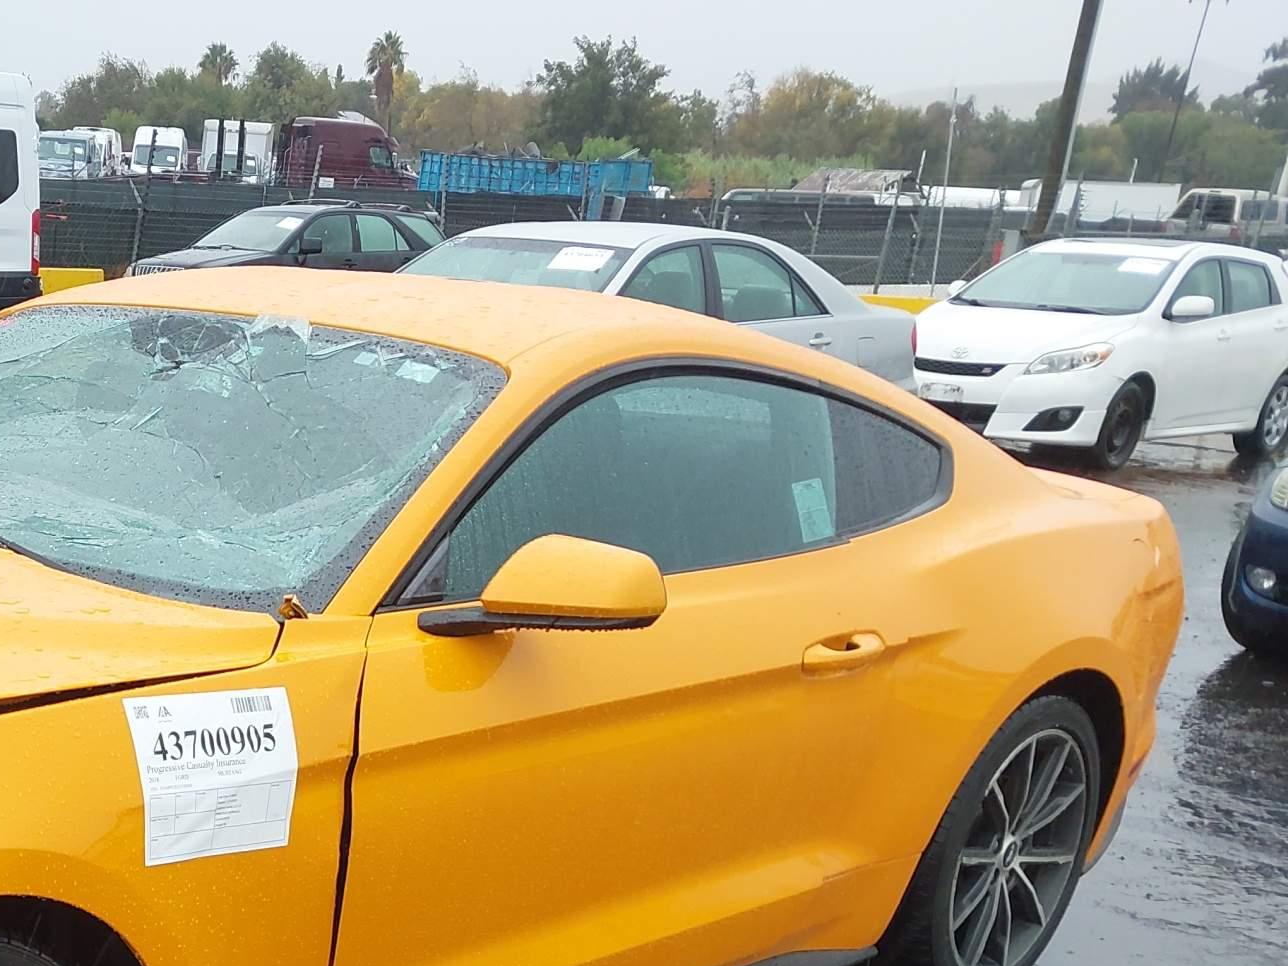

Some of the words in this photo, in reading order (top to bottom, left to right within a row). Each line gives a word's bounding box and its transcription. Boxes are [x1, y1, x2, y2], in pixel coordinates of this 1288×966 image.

[153, 723, 276, 761] 43700905
[146, 762, 186, 775] Progressive
[186, 760, 215, 772] Casualty
[216, 758, 247, 769] Insurance
